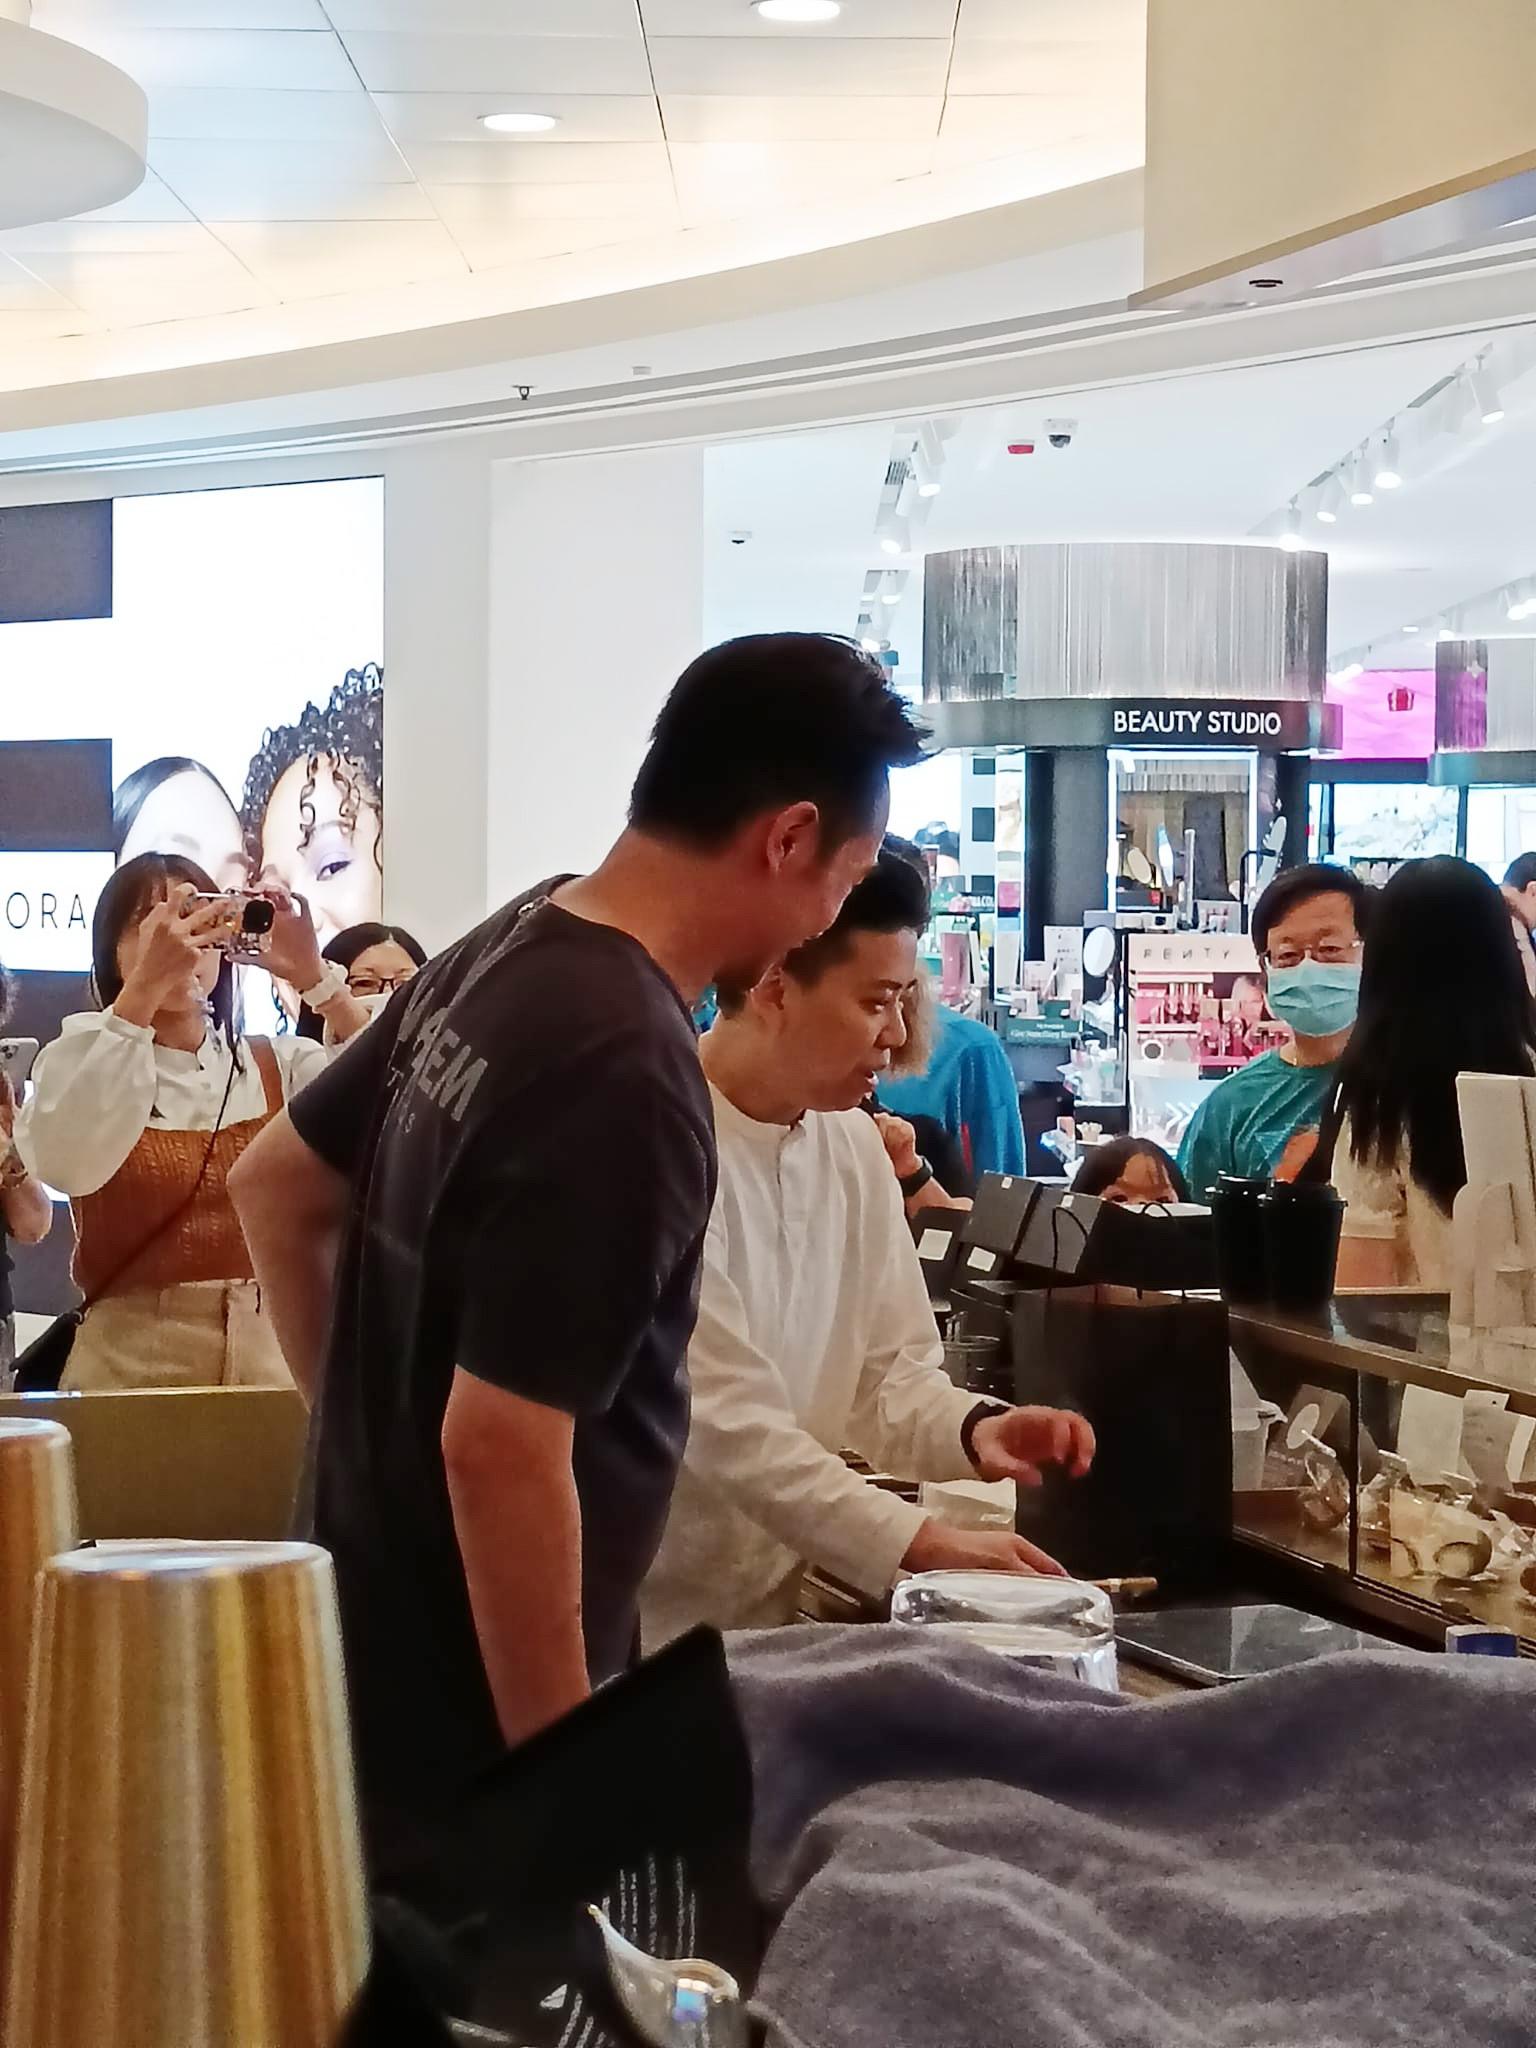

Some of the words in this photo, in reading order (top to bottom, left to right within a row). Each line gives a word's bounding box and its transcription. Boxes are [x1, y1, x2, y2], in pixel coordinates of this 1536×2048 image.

[1113, 710, 1202, 733] BEAUTY
[1207, 711, 1282, 735] STUDIO
[6, 891, 87, 929] ORA
